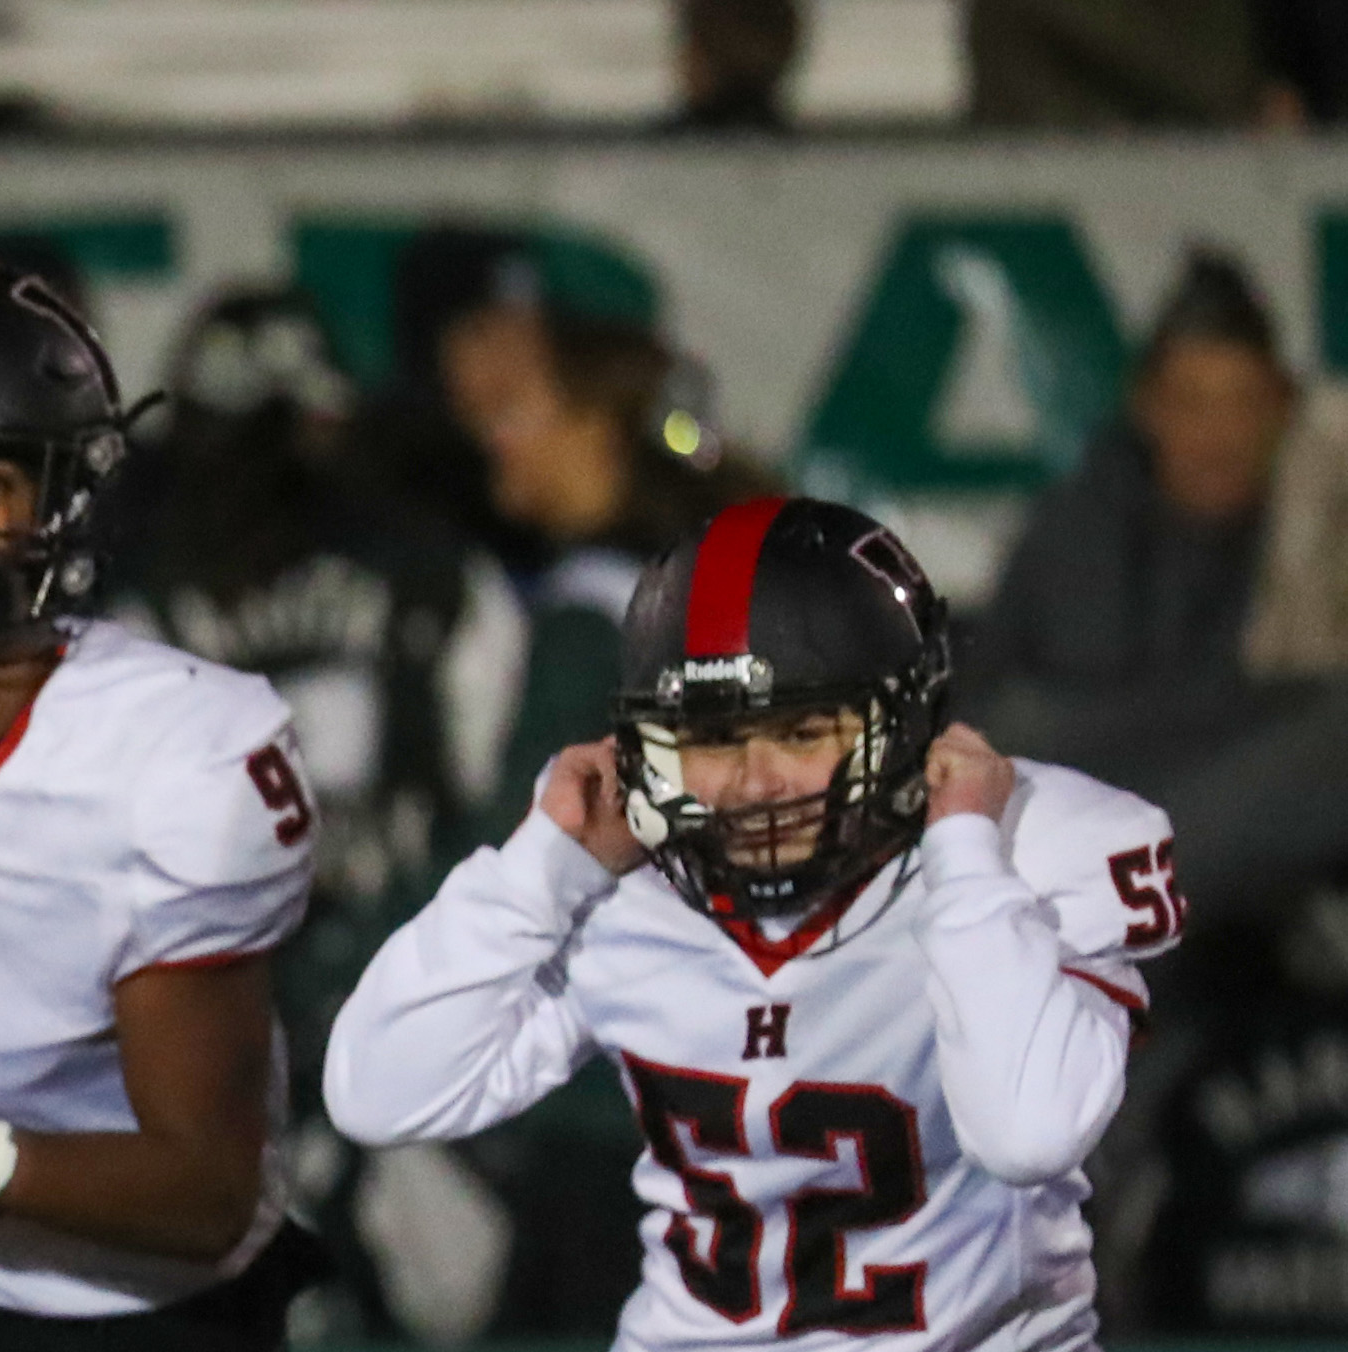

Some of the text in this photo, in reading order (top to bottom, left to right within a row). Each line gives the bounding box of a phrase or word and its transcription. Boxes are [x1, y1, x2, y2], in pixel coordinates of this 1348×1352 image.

[244, 742, 312, 849] 9
[741, 1001, 792, 1061] H
[620, 1047, 931, 1340] 52
